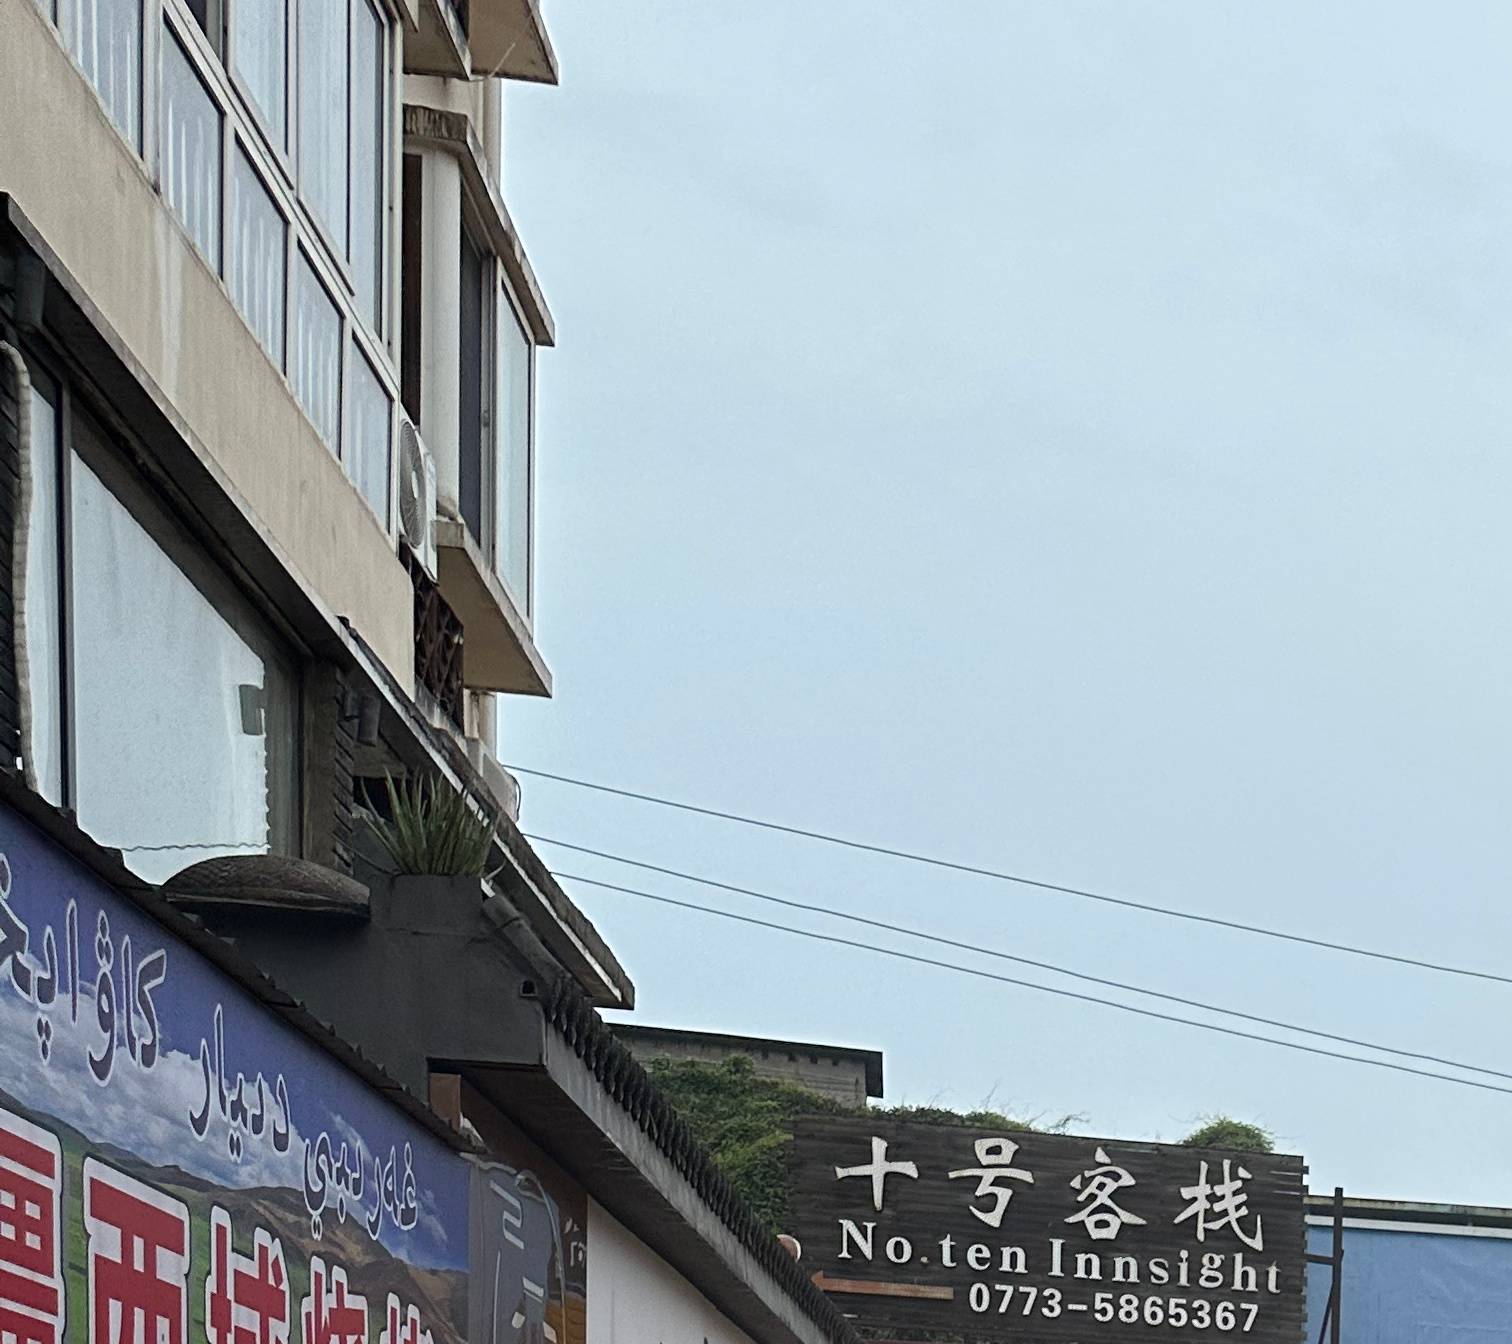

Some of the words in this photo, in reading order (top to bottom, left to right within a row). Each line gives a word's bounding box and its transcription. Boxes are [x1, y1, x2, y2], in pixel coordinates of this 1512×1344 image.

[834, 1136, 1264, 1251] 十号客栈
[1048, 1237, 1282, 1294] Innsight
[969, 1282, 1259, 1332] 0773-5865367
